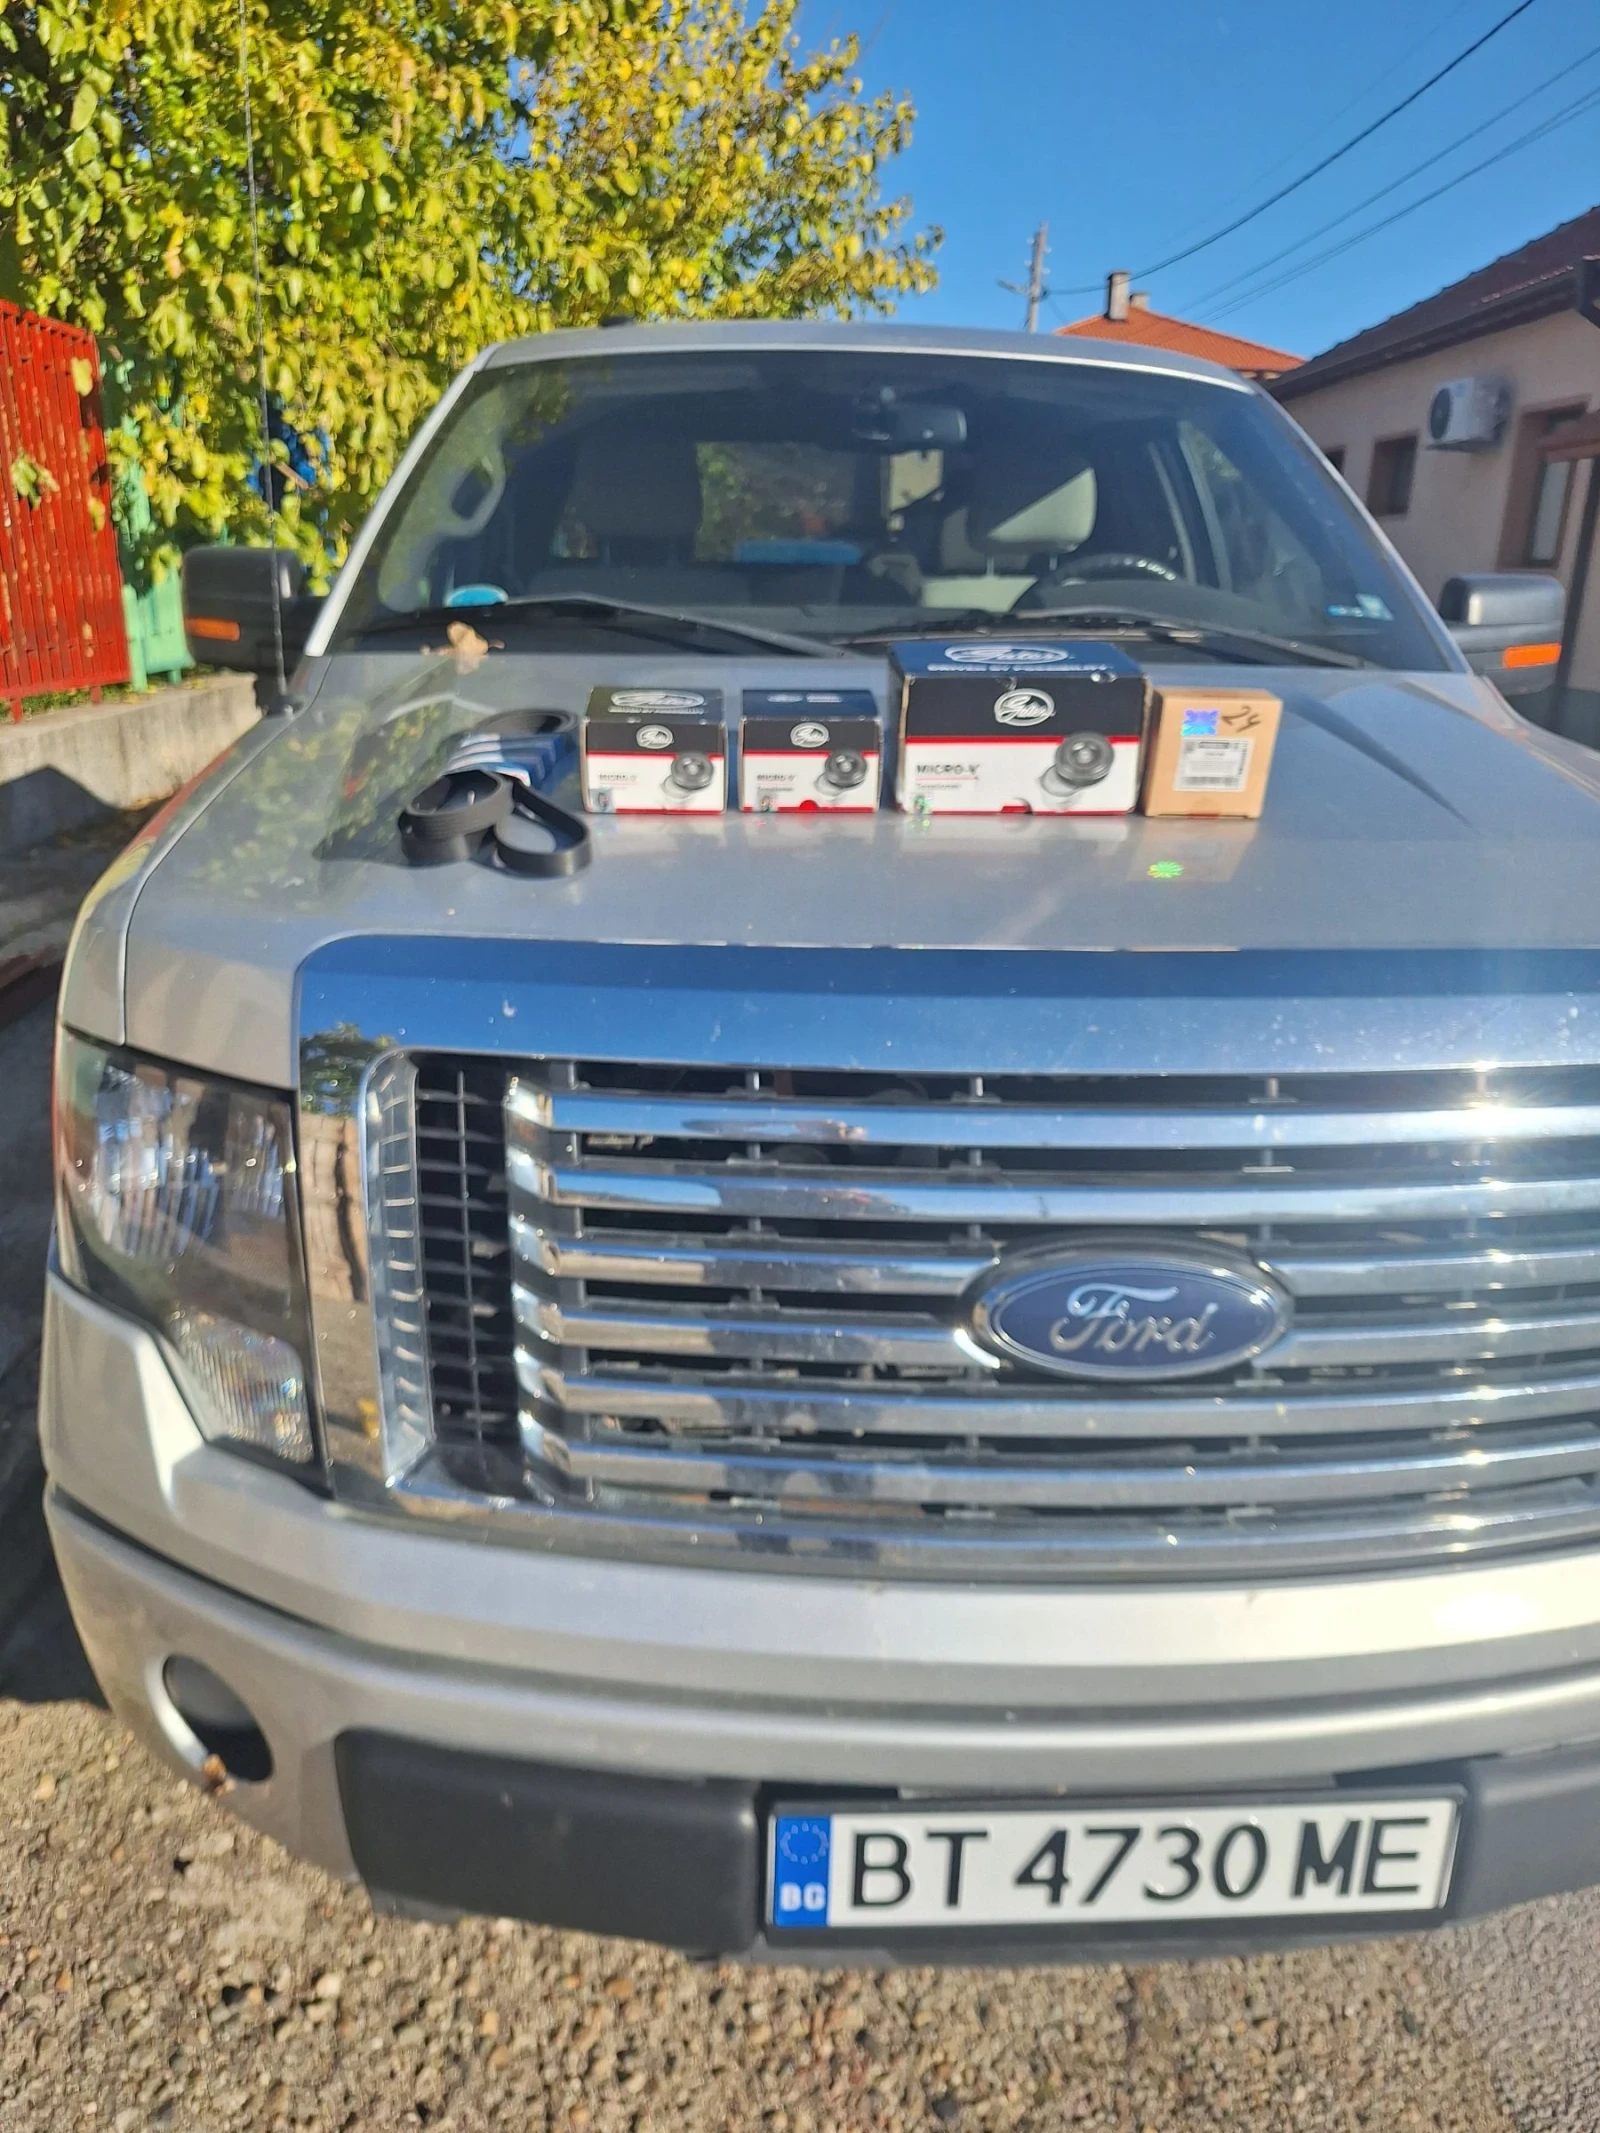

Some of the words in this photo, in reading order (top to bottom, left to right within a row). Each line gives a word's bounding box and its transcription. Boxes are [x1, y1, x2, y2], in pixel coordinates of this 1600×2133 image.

[915, 763, 981, 776] MICRO-V
[1049, 1282, 1218, 1353] Ford
[851, 1829, 989, 1908] BT
[1013, 1814, 1269, 1905] 4730
[1291, 1816, 1431, 1899] ME
